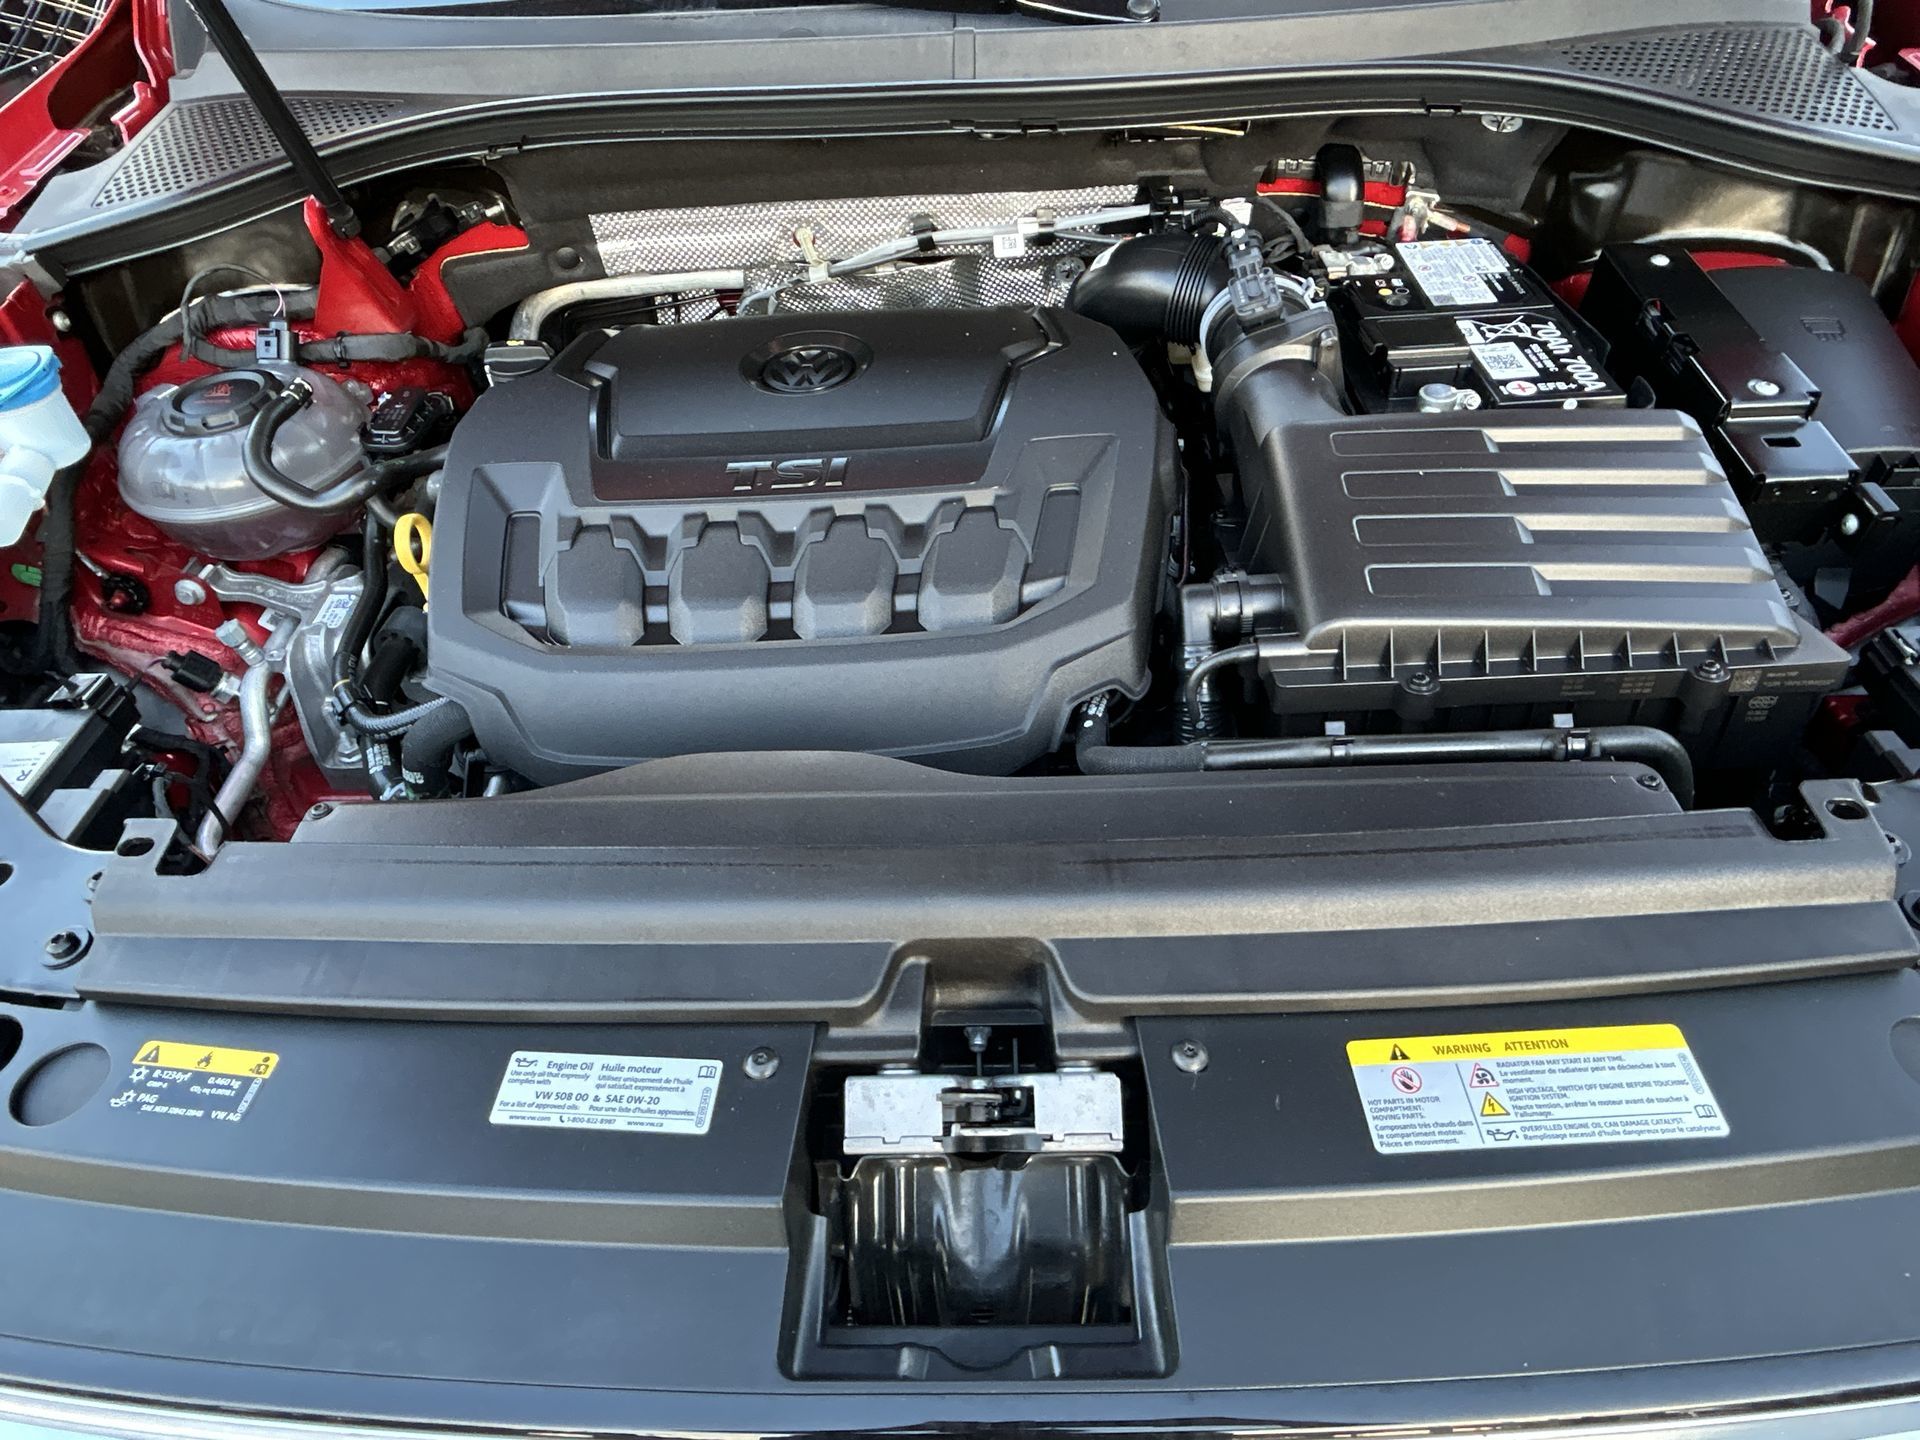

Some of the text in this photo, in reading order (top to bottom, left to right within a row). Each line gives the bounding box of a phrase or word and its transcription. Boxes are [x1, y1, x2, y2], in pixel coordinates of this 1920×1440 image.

[1531, 321, 1573, 355] 70Ah
[1559, 355, 1607, 392] 700A
[725, 457, 851, 491] TSI
[1433, 1038, 1569, 1054] WARNING ATTENTION
[546, 1060, 593, 1071] Engine Oil
[601, 1063, 662, 1073] Huile moteur
[152, 1069, 192, 1083] R-1234yf
[230, 1079, 242, 1089] kg
[507, 1077, 535, 1085] complies
[623, 1075, 662, 1084] uniquement
[137, 1093, 159, 1104] PAG
[534, 1091, 553, 1099] VW
[554, 1092, 573, 1100] 508
[575, 1093, 589, 1101] 00
[605, 1094, 623, 1102] SAE
[626, 1095, 660, 1104] 0W-20
[535, 1102, 565, 1110] approved
[1374, 1122, 1417, 1131] Composants
[1385, 1130, 1436, 1139] compartiment
